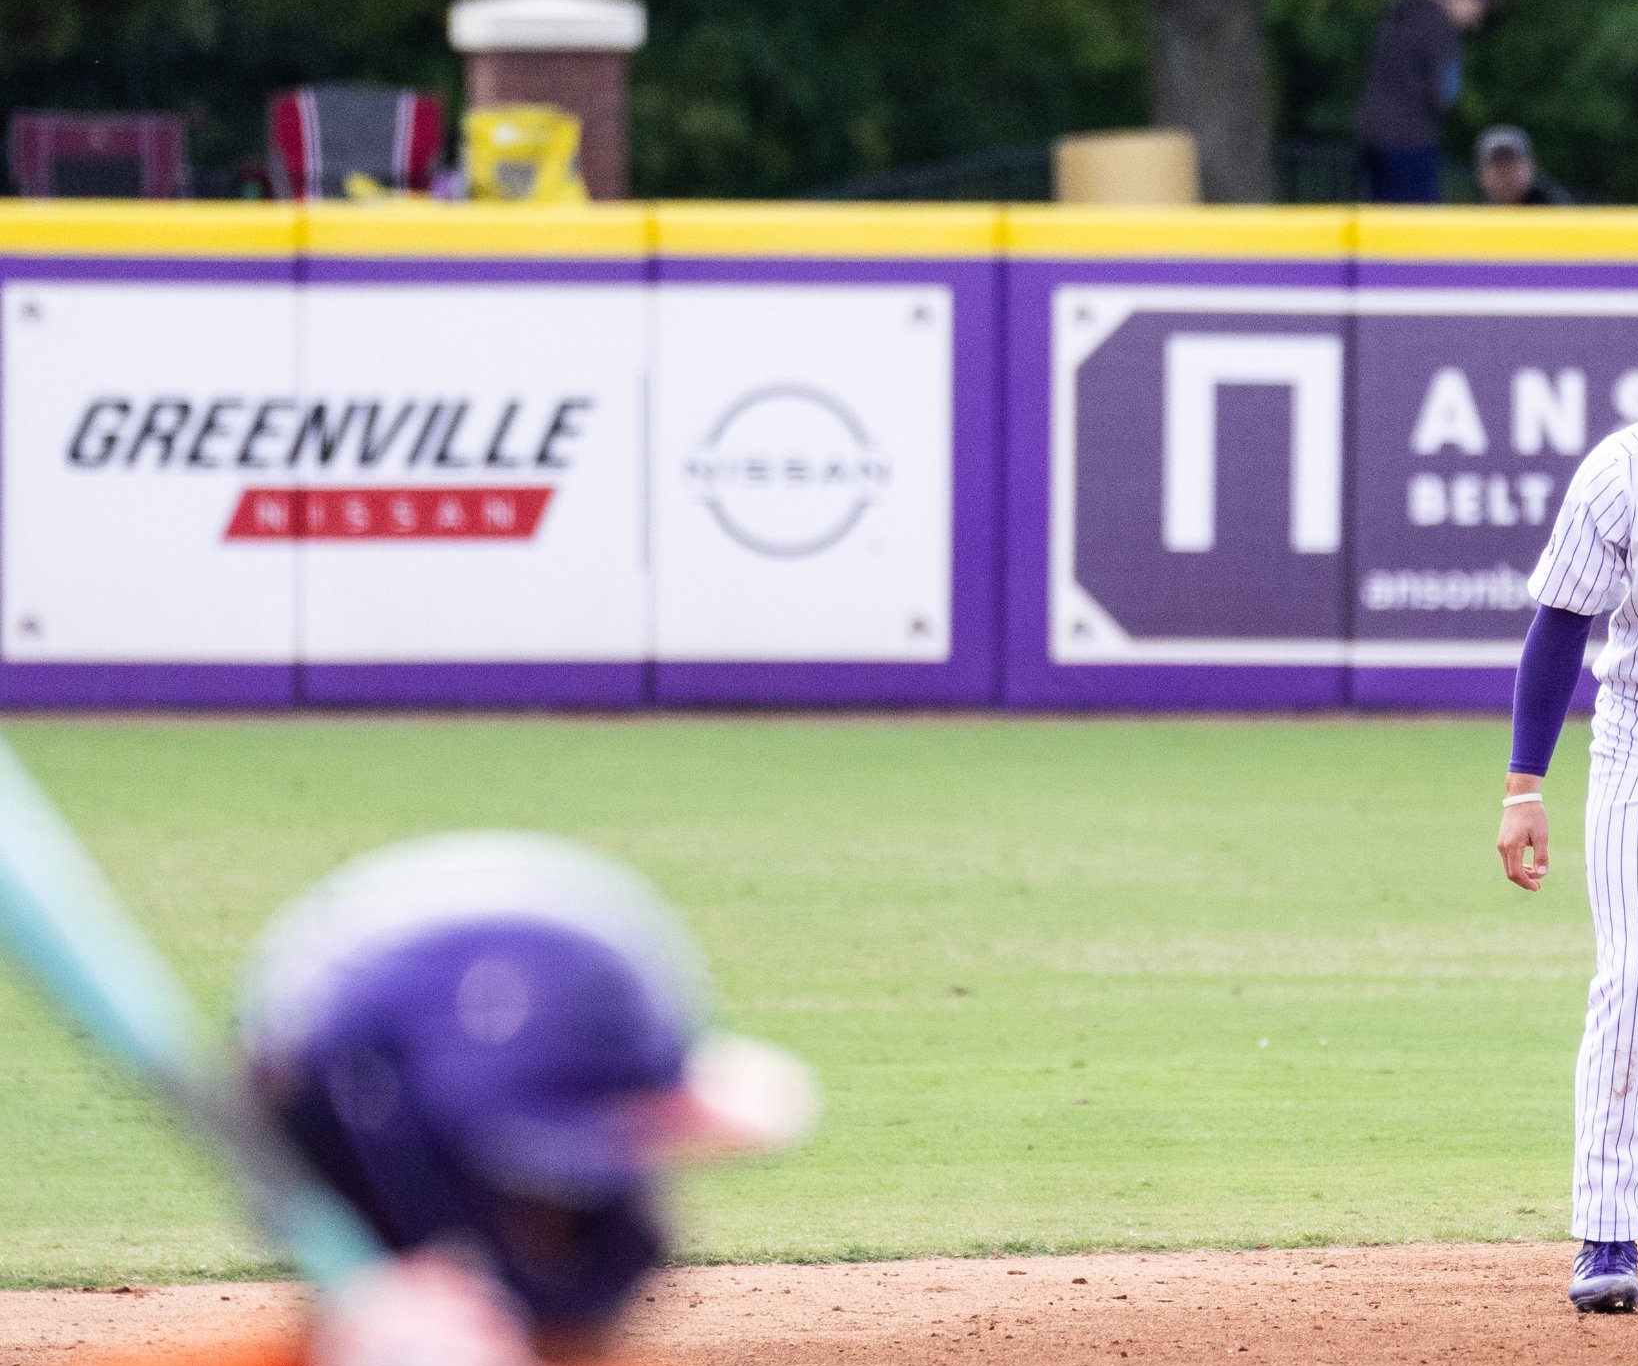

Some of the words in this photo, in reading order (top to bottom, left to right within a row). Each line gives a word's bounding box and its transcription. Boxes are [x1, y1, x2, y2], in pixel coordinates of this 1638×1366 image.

[66, 397, 594, 470] GREENVILLE
[253, 497, 517, 532] NISSAN
[1407, 472, 1553, 526] BELT
